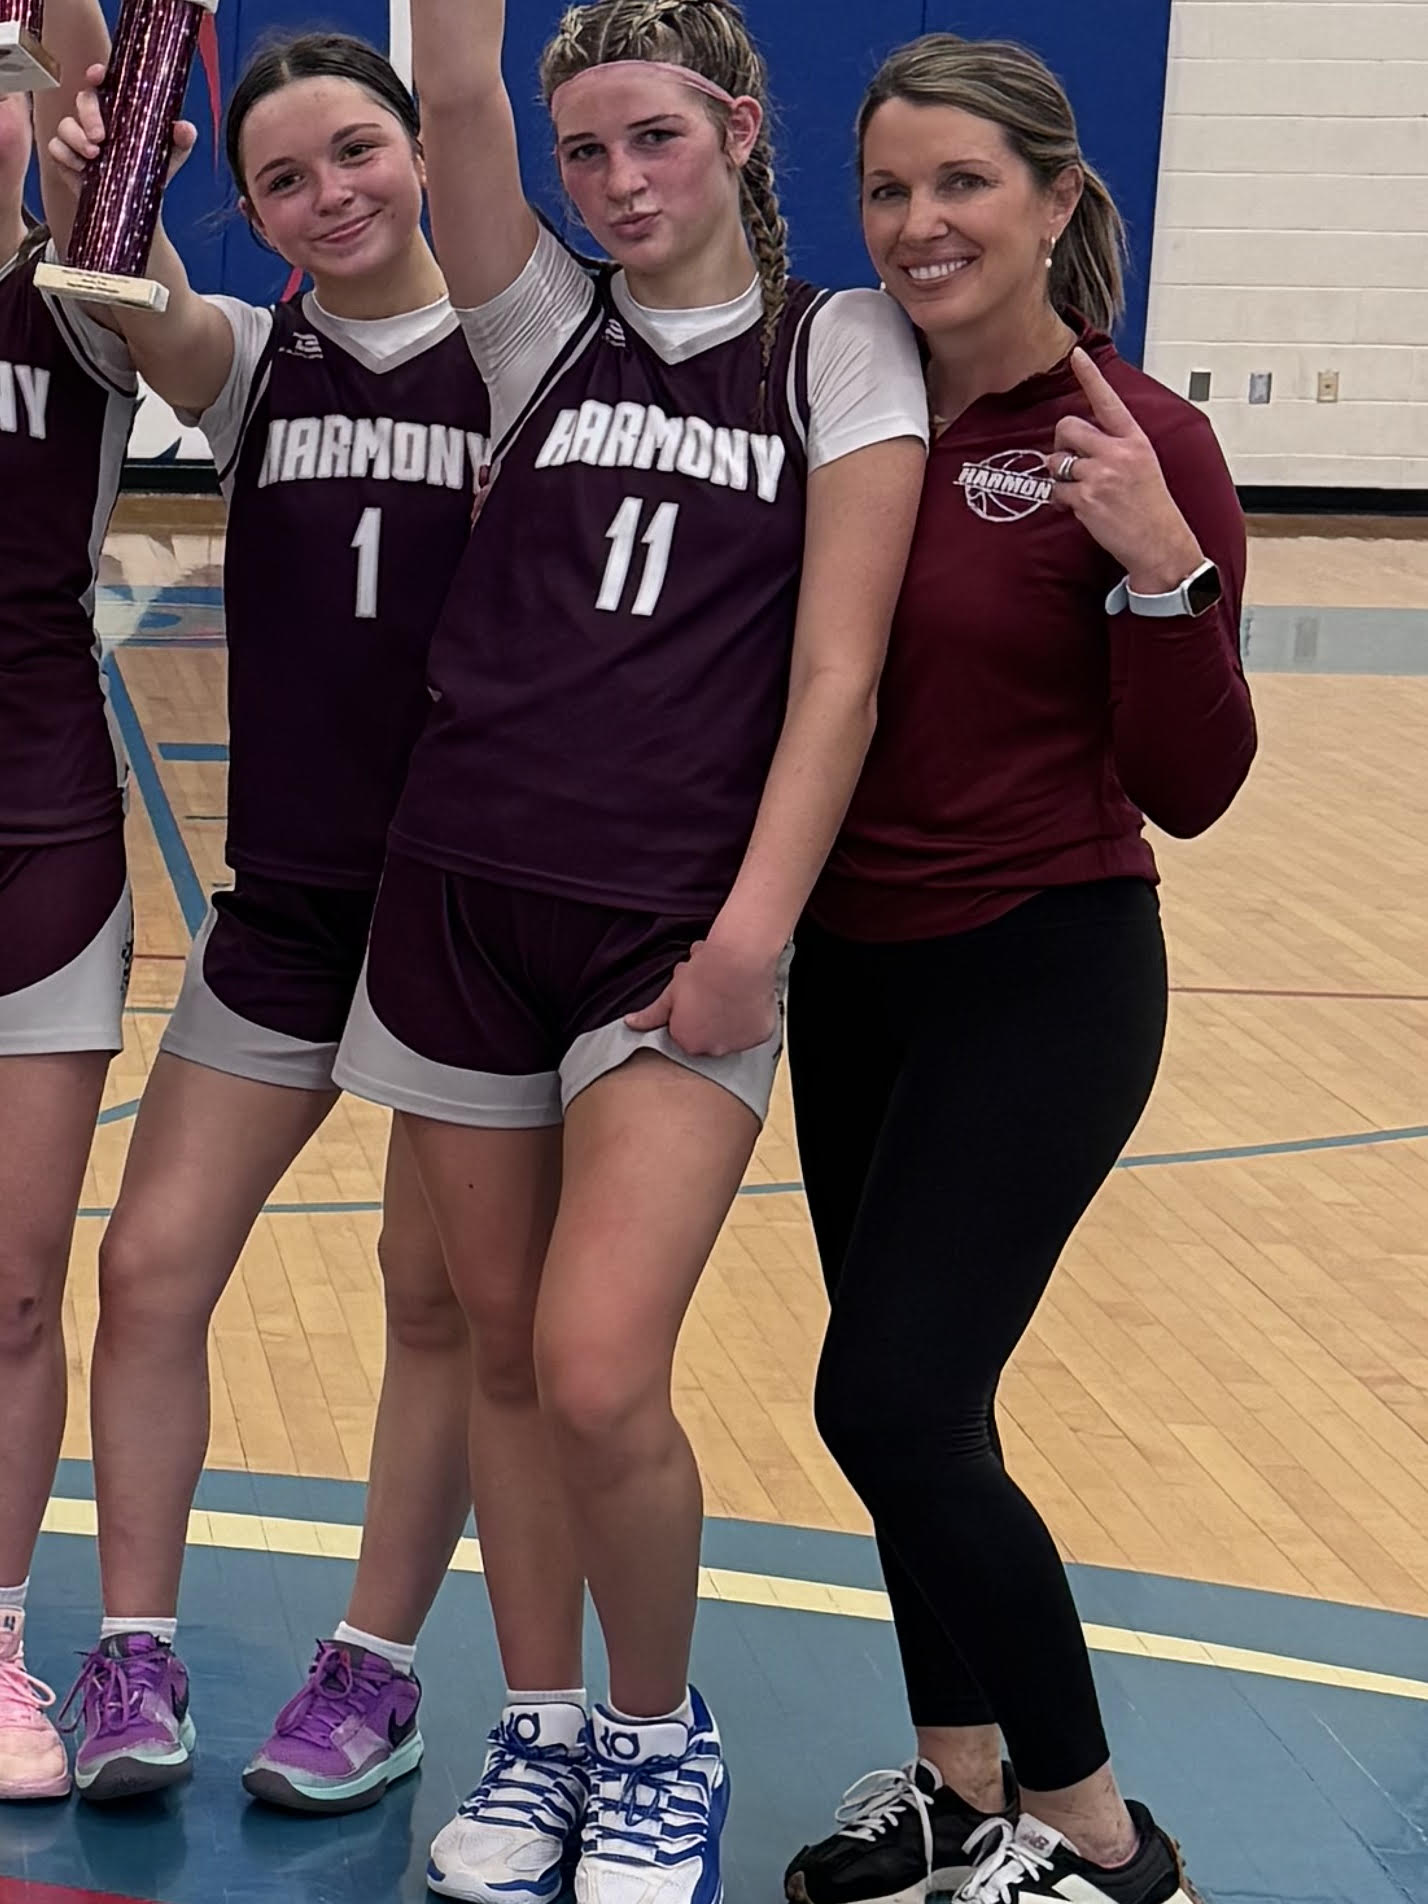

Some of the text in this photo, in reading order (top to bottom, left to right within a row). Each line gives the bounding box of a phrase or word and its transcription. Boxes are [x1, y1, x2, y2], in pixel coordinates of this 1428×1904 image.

[534, 399, 787, 503] HARMONY
[958, 467, 1053, 499] HARMON
[350, 506, 382, 619] 1
[594, 497, 680, 616] 11
